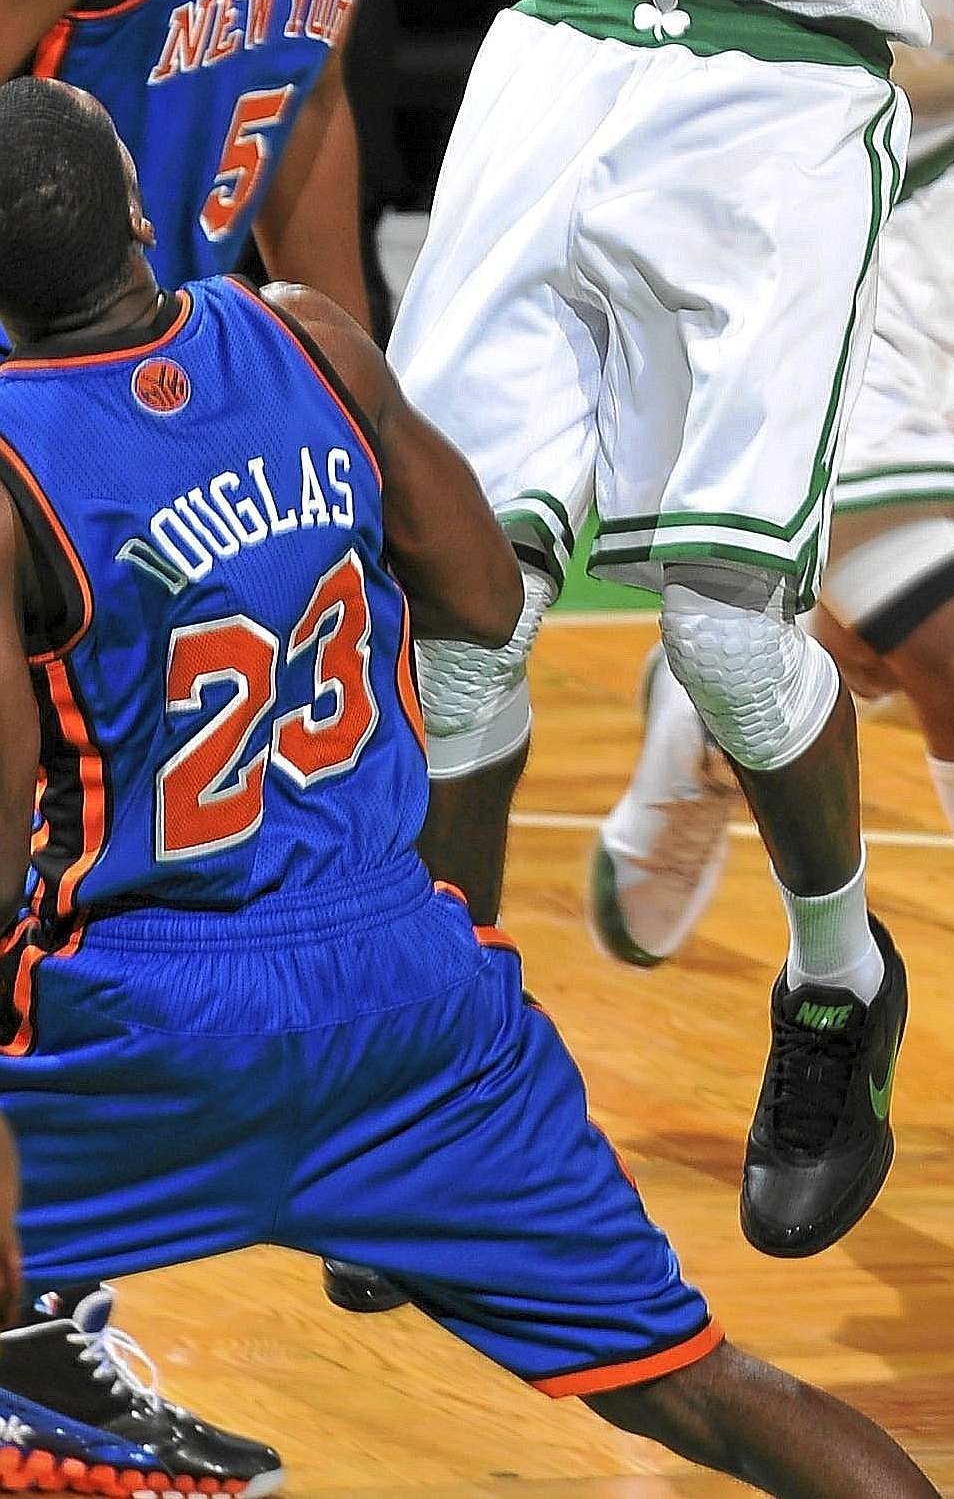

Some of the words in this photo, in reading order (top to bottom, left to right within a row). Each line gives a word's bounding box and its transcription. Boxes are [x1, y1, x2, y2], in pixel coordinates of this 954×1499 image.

[198, 82, 295, 243] 5
[113, 446, 356, 597] DOUGLAS
[155, 547, 380, 862] 23
[795, 1001, 854, 1031] NIKE
